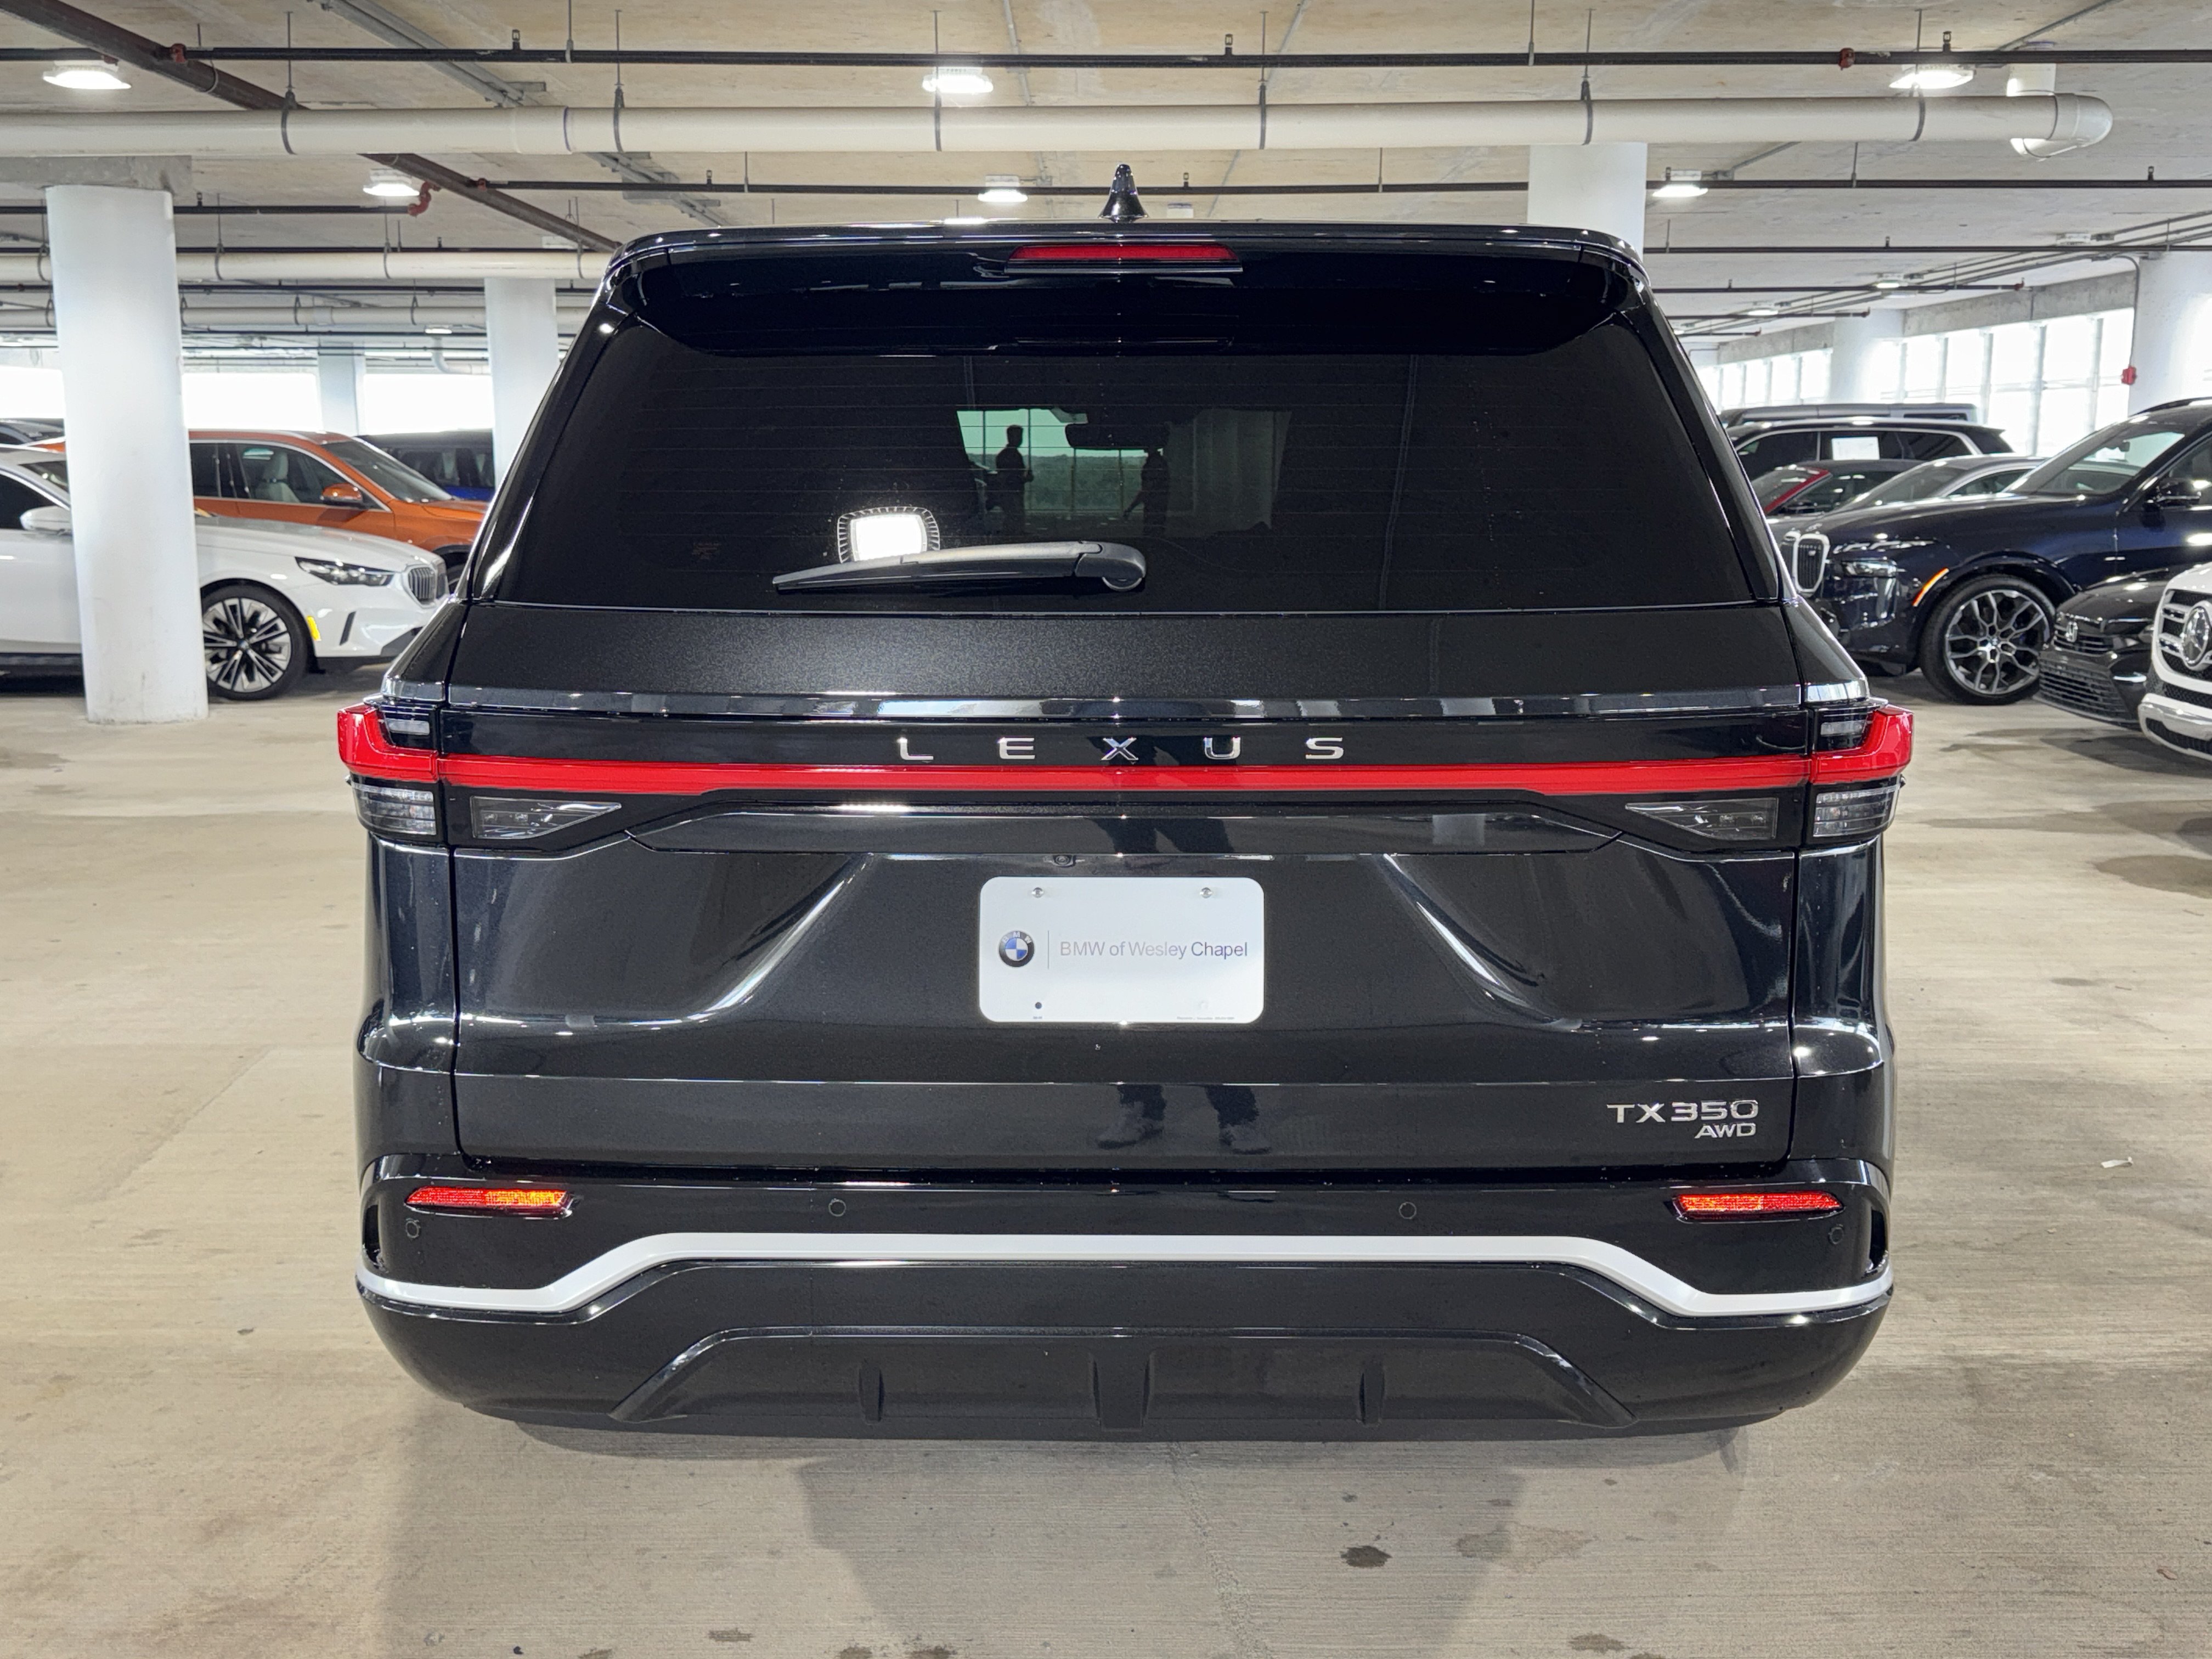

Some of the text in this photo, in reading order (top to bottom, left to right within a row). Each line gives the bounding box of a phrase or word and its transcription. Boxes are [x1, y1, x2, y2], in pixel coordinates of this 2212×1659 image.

[897, 737, 1345, 761] LEXUS
[1002, 931, 1032, 944] BMW
[1060, 941, 1248, 960] BMW of Wesley Chapel
[1694, 1122, 1757, 1139] AWD
